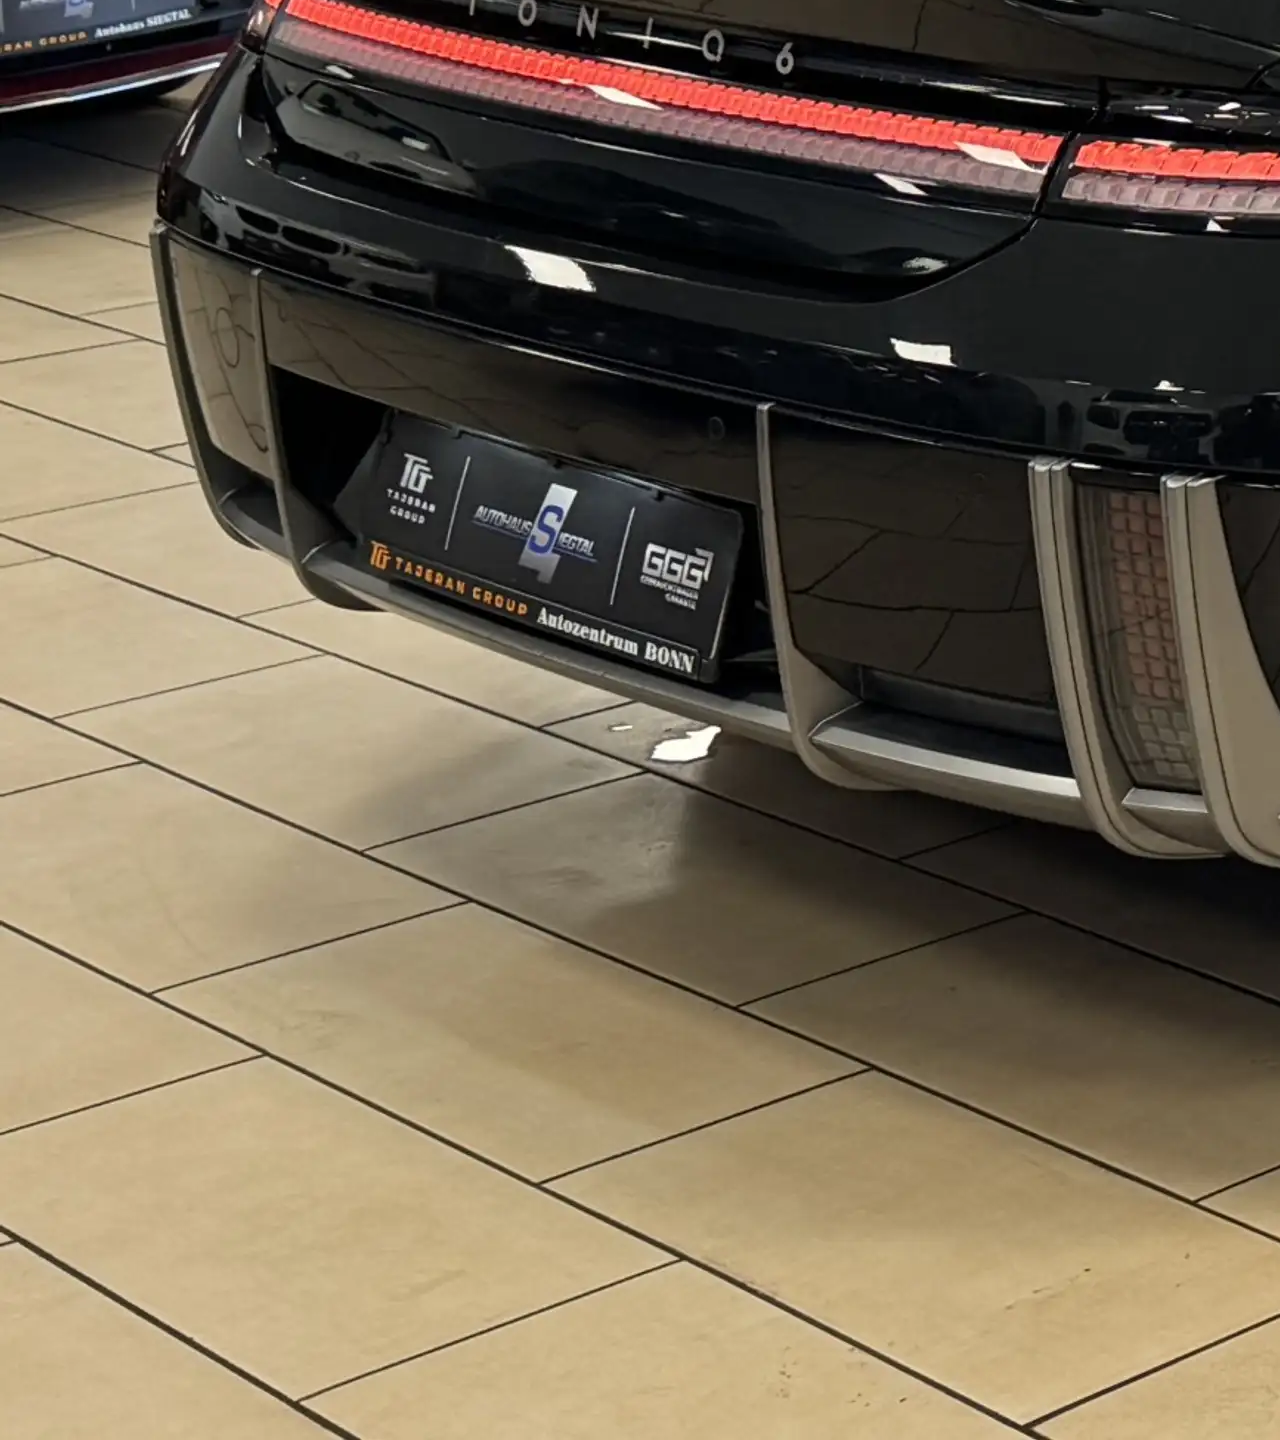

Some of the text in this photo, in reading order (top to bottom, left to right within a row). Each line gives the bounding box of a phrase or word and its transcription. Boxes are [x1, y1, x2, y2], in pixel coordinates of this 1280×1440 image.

[0, 39, 33, 54] RAN
[775, 42, 795, 75] 6
[473, 505, 533, 535] AUTOHAUS
[395, 556, 466, 595] TAJERAN
[472, 586, 528, 616] GROUP
[536, 606, 638, 656] Autozentrum
[644, 640, 695, 674] BONN
